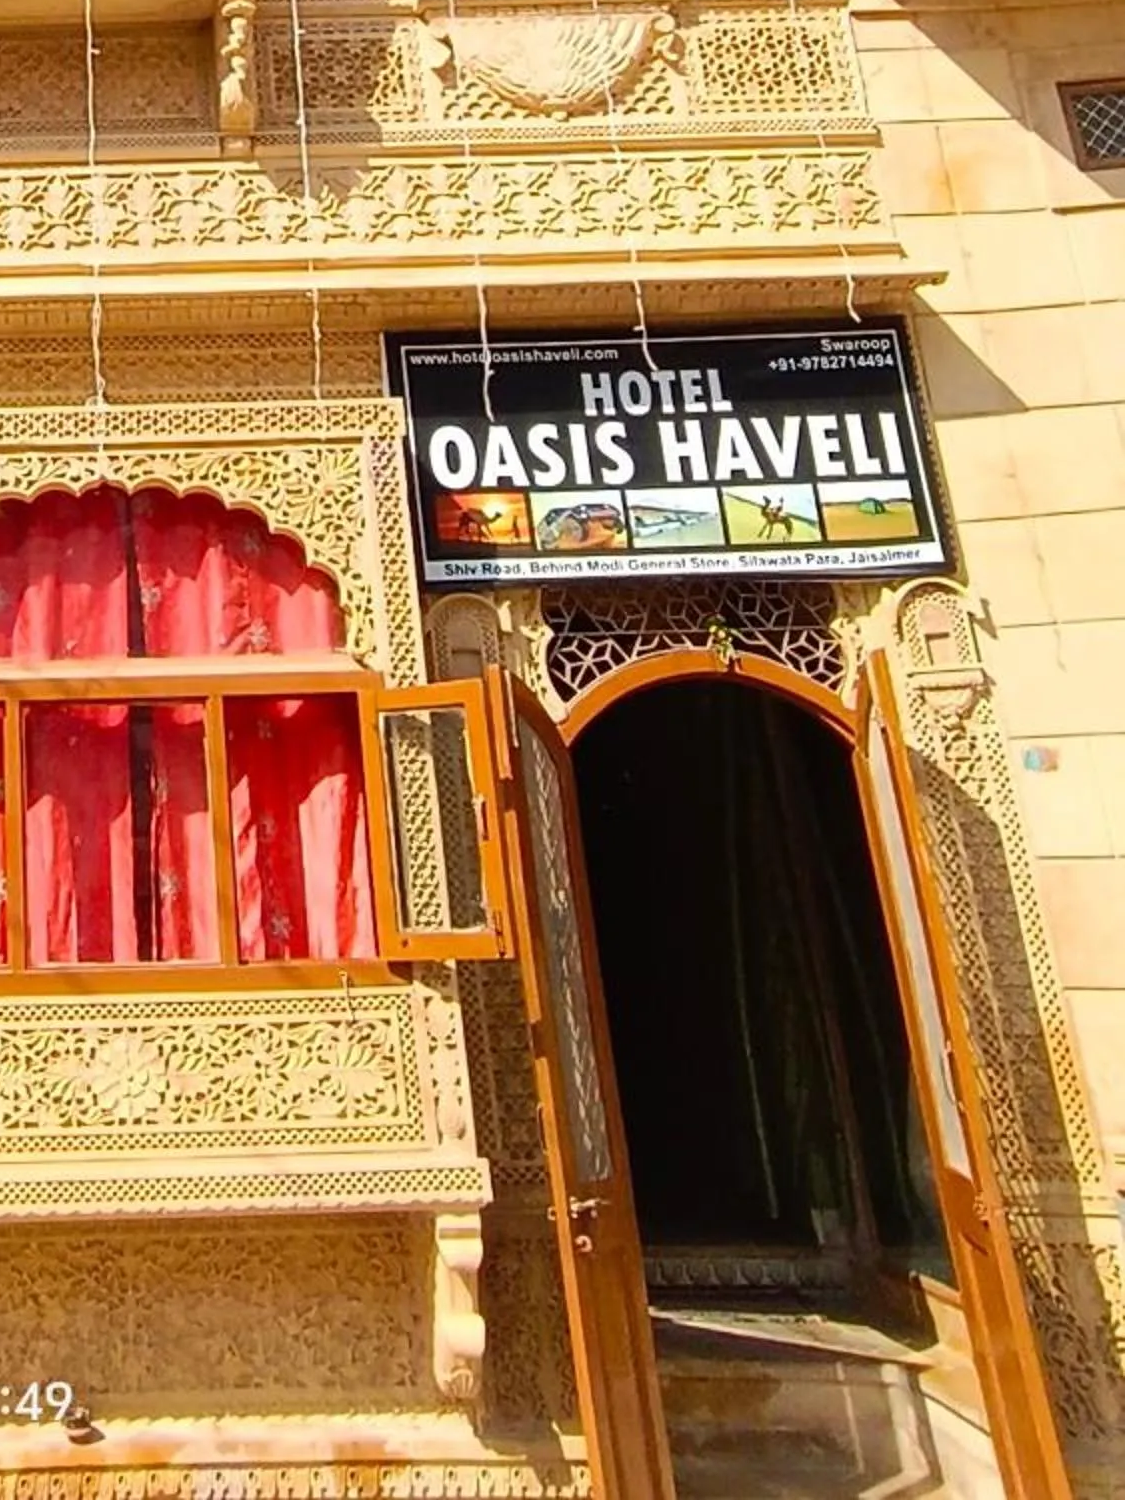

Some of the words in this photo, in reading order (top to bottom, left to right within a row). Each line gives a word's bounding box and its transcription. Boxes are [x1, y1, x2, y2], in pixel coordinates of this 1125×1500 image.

[820, 338, 891, 352] Swaroop
[580, 369, 733, 417] HOTEL
[428, 420, 636, 490] OASIS
[657, 412, 907, 483] HAVELI
[627, 557, 686, 571] General
[848, 548, 921, 564] Jaisalmer
